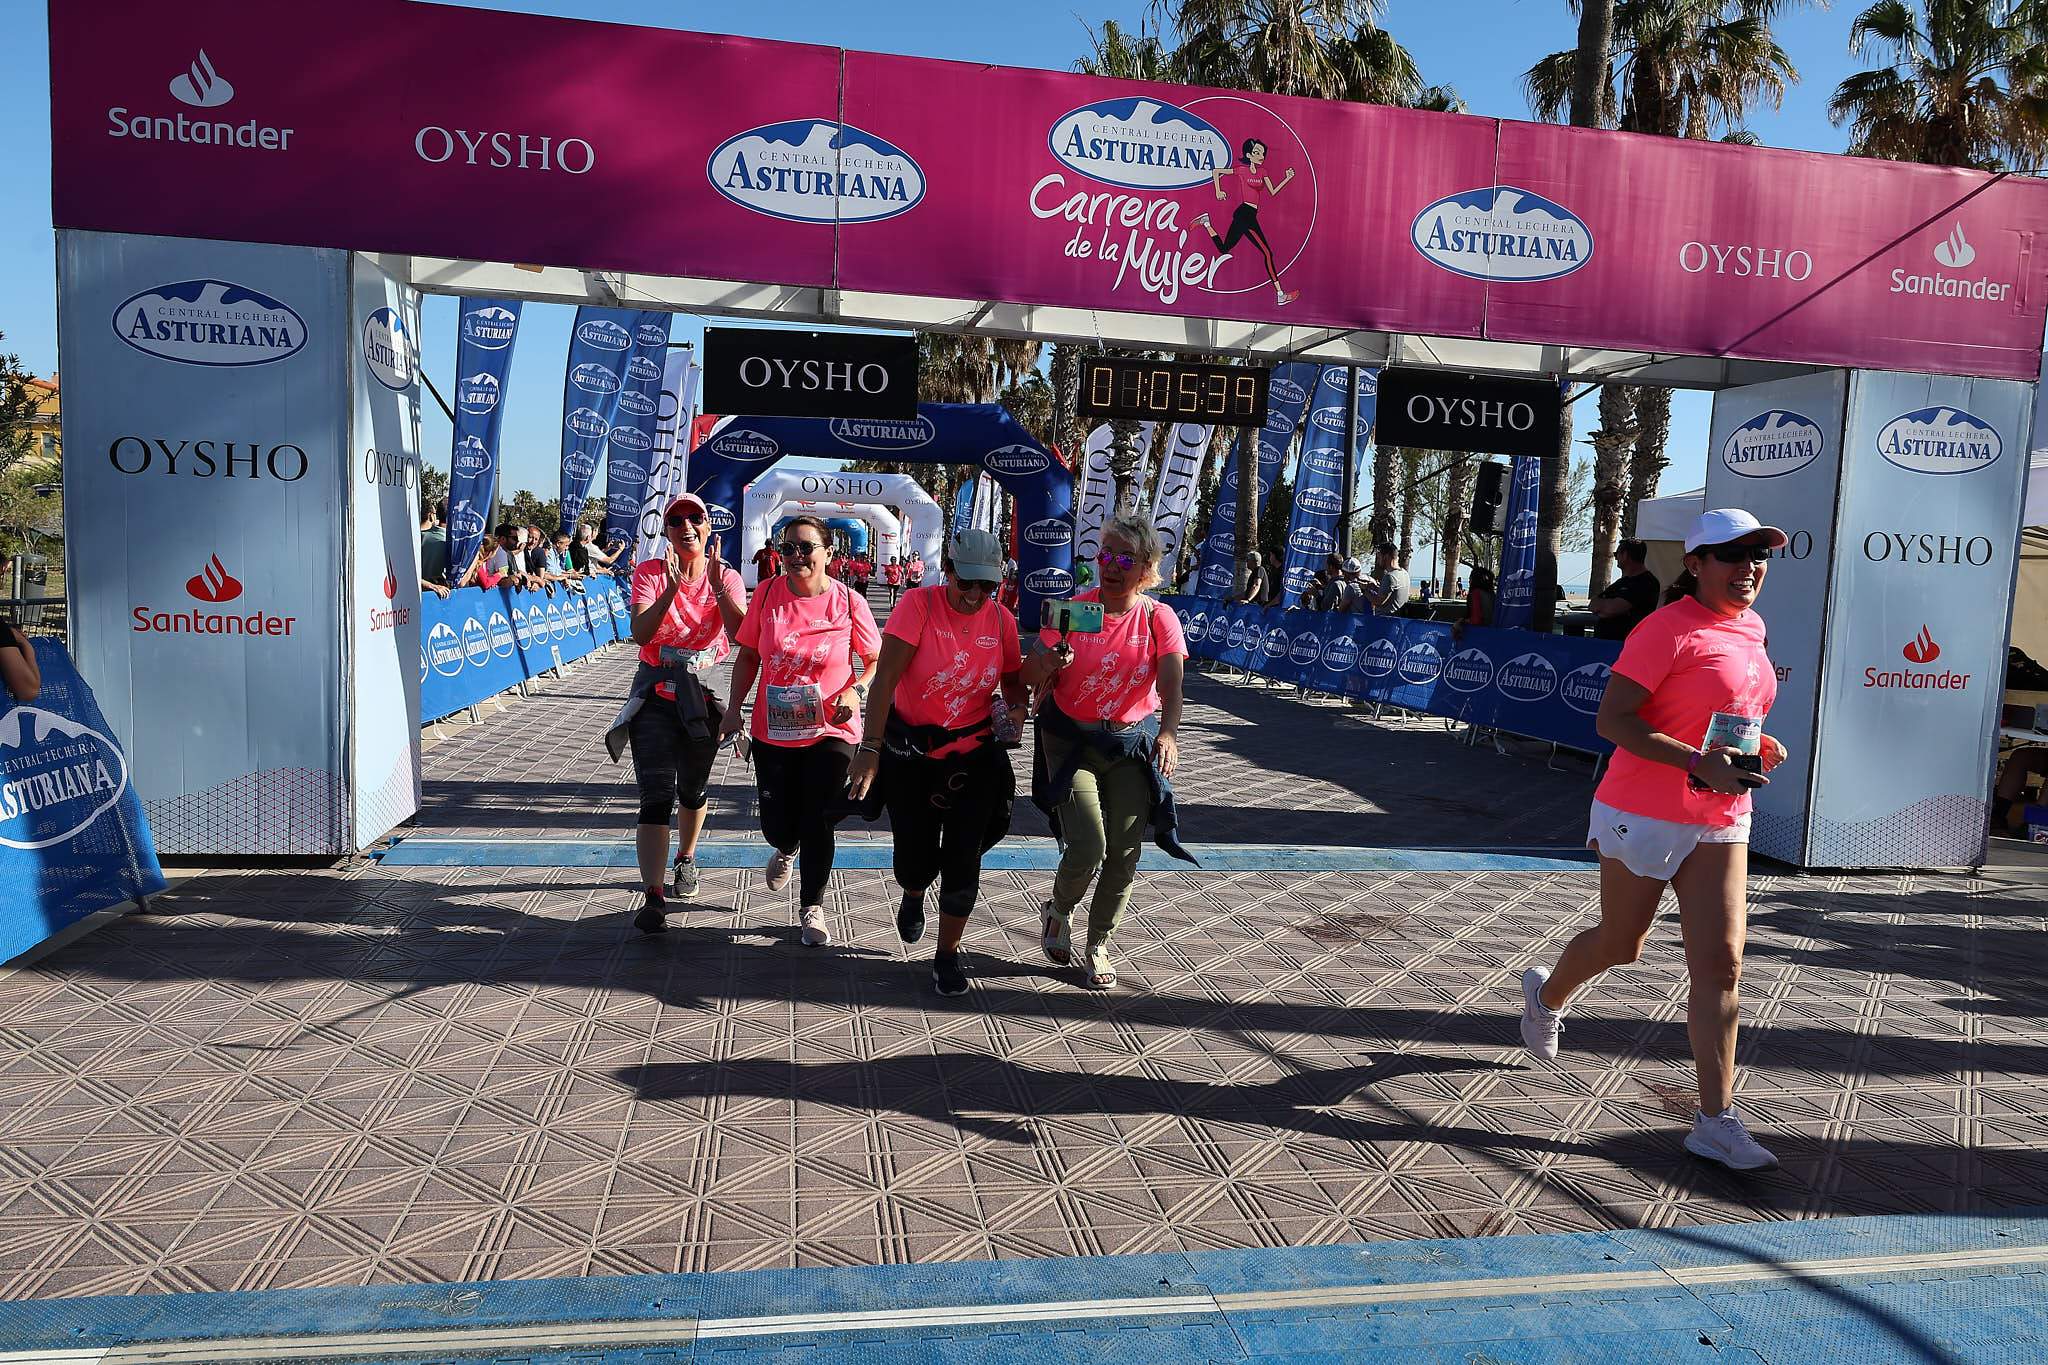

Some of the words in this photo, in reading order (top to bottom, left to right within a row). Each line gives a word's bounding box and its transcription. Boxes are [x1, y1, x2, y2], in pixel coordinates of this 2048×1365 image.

[108, 106, 294, 151] Santander
[1092, 123, 1150, 139] CENTRAL
[1155, 131, 1213, 145] LECHERA
[415, 126, 595, 174] OYSHO
[759, 151, 828, 166] CENTRAL
[1063, 123, 1217, 172] ASTURIANA
[724, 151, 909, 202] ASTURIANA
[1029, 173, 1180, 232] Carrera
[1425, 215, 1579, 262] ASTURIANA
[1455, 215, 1512, 229] CENTRAL
[1517, 221, 1575, 234] LECHERA
[1064, 226, 1093, 258] de
[1098, 228, 1119, 262] la
[1112, 229, 1233, 305] Mujer
[1680, 240, 1813, 282] OYSHO
[1890, 268, 2010, 302] Santander
[127, 307, 294, 349] ASTURIANA
[158, 307, 220, 319] CENTRAL
[225, 312, 287, 323] LECHERA
[739, 356, 889, 395] OYSHO
[1091, 367, 1255, 414] 01:05:39
[1406, 394, 1535, 433] OYSHO
[837, 419, 928, 441] ASTURIANA
[1744, 433, 1776, 444] CENTRAL
[1779, 429, 1813, 440] LECHERA
[1906, 428, 1946, 437] CENTRAL
[1949, 431, 1991, 440] LECHERA
[715, 440, 773, 455] ASTURIANA
[1728, 439, 1815, 465] ASTURIANA
[1884, 429, 1992, 460] ASTURIANA
[109, 436, 309, 482] OYSHO
[365, 449, 415, 490] OYSHO
[989, 456, 1046, 468] ASTURIANA
[801, 476, 883, 497] OYSHO
[1863, 531, 1993, 566] OYSHO
[133, 605, 296, 637] Santander
[370, 607, 411, 632] Santander
[1400, 656, 1438, 676] ASTURIANA
[1446, 661, 1488, 684] ASTURIANA
[1863, 666, 1971, 691] Santander
[1500, 668, 1551, 693] ASTURIANA
[1564, 677, 1604, 702] ASTURI
[46, 742, 98, 762] LECHERA
